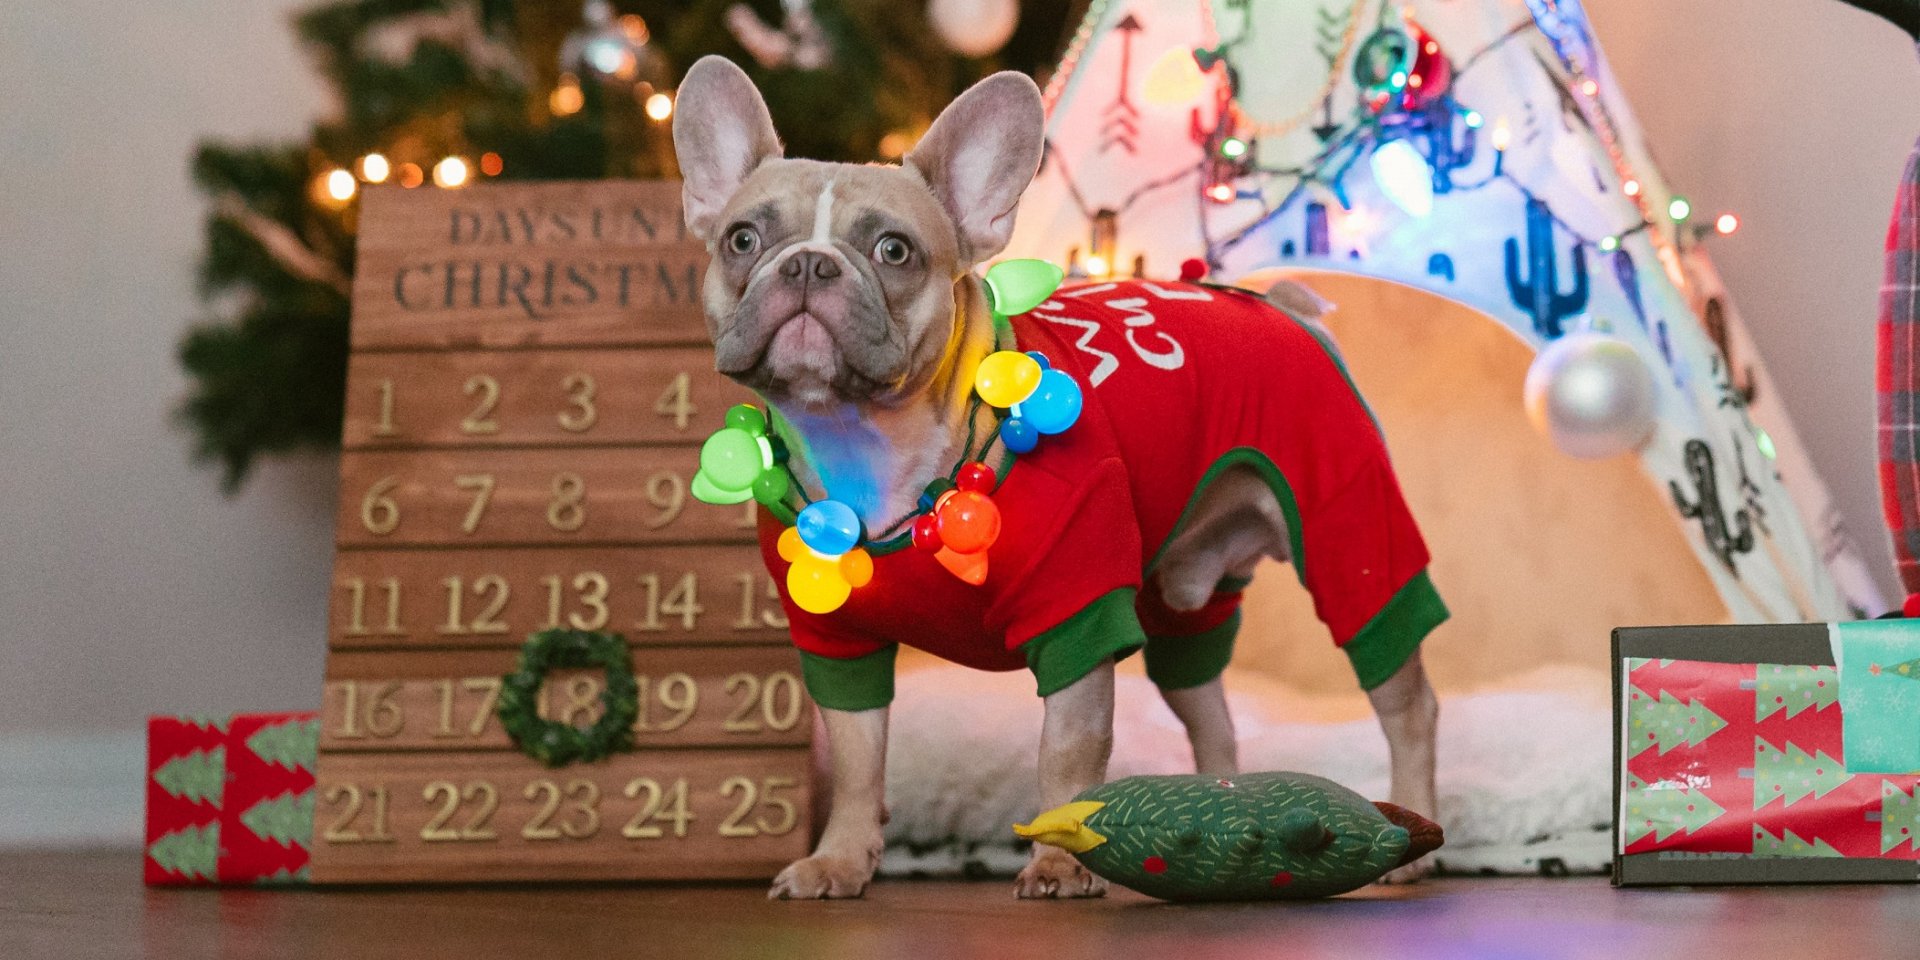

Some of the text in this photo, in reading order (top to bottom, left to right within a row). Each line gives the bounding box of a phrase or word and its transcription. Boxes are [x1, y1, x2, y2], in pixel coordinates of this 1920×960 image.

[447, 205, 686, 245] DAYS UNT
[393, 259, 699, 320] CHRISTM
[371, 372, 698, 436] 1 2 3 4
[361, 476, 400, 534] 6
[455, 475, 495, 533] 7
[547, 472, 585, 531] 8
[646, 470, 685, 529] 9
[343, 578, 404, 636] 11
[438, 574, 510, 635] 12
[540, 571, 610, 633] 13
[637, 571, 704, 631] 14
[332, 679, 404, 740] 16
[431, 677, 502, 738] 17
[632, 672, 698, 733] 19
[723, 672, 801, 732] 20
[324, 776, 797, 844] 21 22 23 24 25
